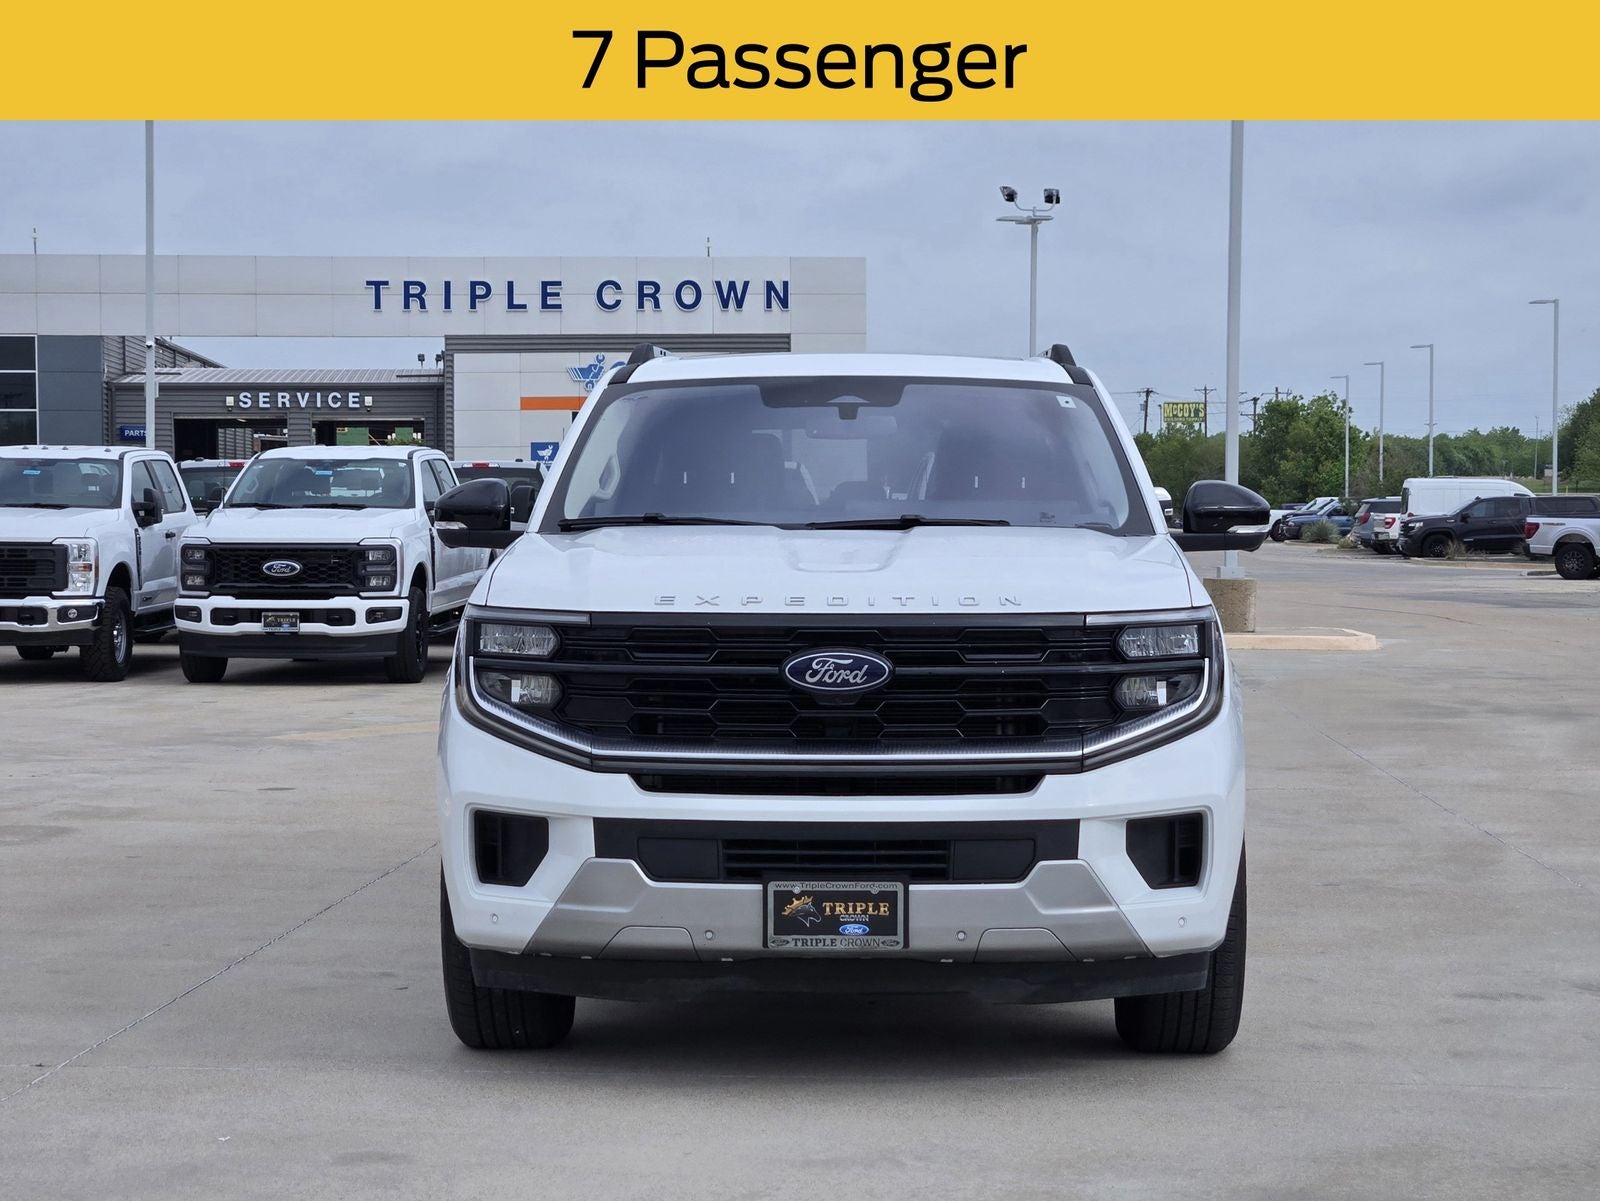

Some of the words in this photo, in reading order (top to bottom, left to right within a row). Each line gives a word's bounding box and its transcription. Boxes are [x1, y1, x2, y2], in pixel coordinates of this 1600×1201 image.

[365, 279, 564, 312] TRIPLE
[594, 279, 791, 312] CROWN
[238, 392, 361, 408] SERVICE
[654, 595, 1022, 606] EXPEDITION
[805, 657, 868, 684] Ford
[774, 882, 898, 890] www.TripleCrownFord.com
[822, 902, 890, 916] TRIPLE
[792, 938, 837, 947] TRIPLE
[840, 938, 880, 948] CROWN
